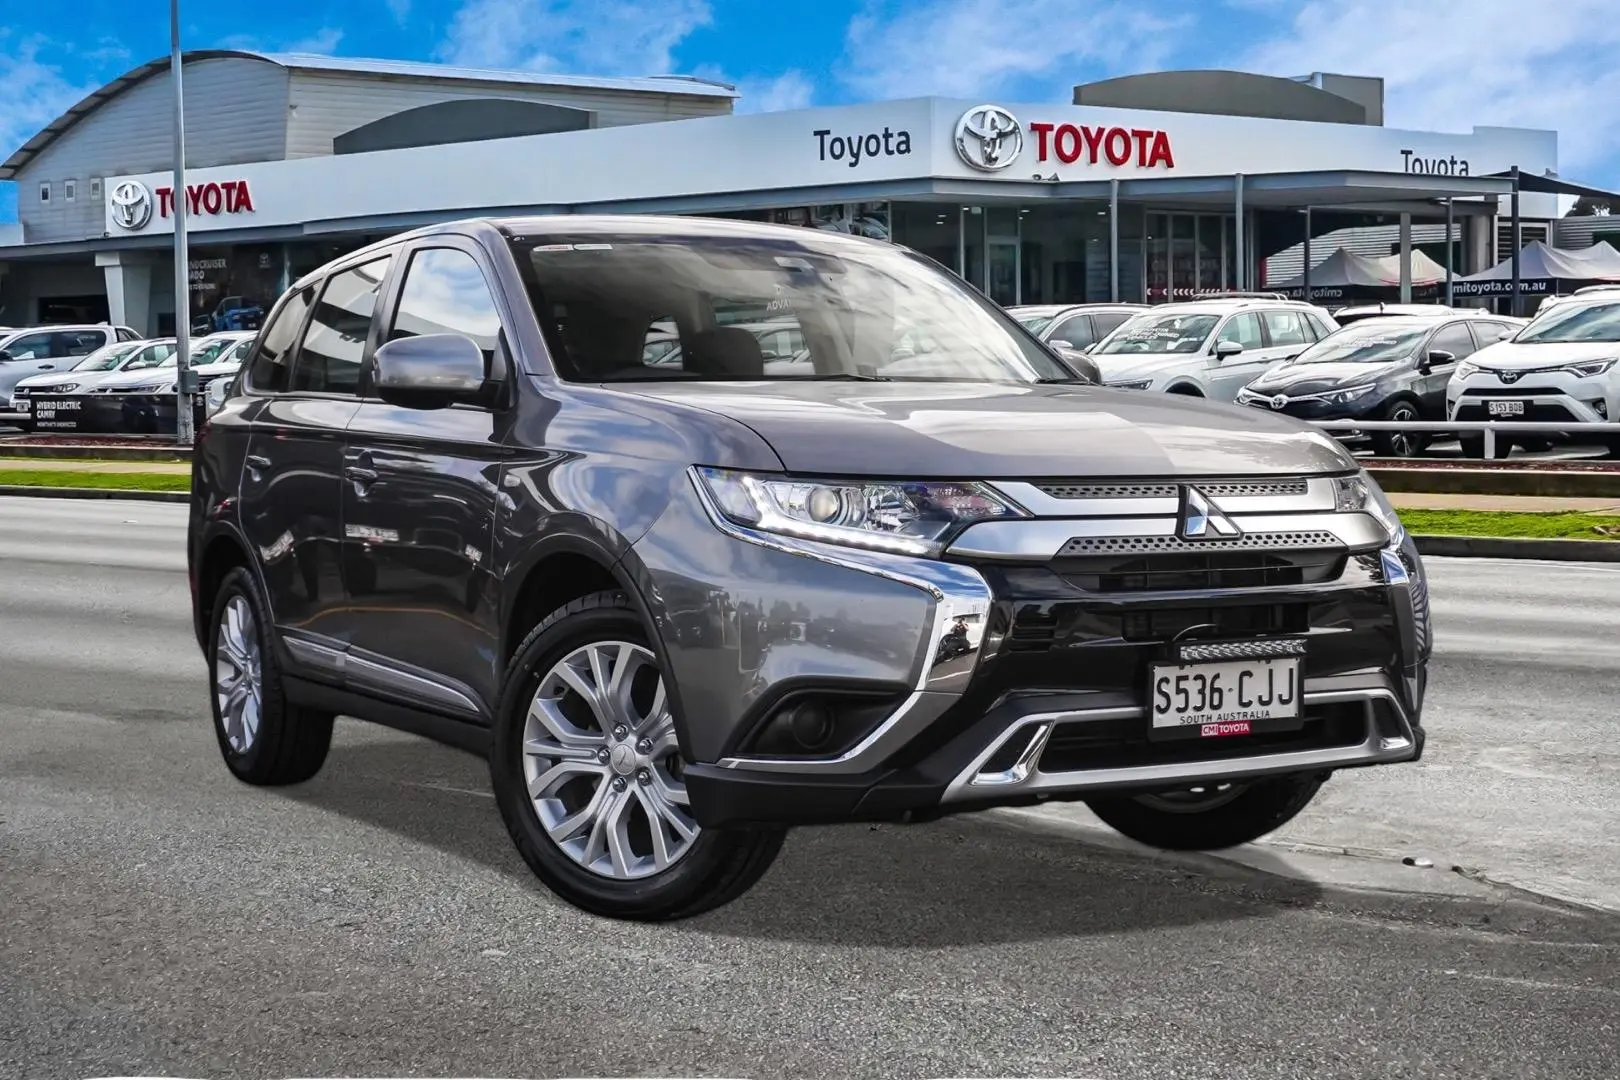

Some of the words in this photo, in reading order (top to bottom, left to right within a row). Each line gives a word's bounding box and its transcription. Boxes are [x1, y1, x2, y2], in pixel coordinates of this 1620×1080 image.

[813, 125, 911, 168] Toyota
[1030, 122, 1175, 169] TOYOTA
[56, 401, 82, 410] ELECTRIC
[1180, 714, 1213, 725] SOUTH
[1216, 709, 1271, 721] AUSTRALIA
[1219, 723, 1250, 734] TOYOTA
